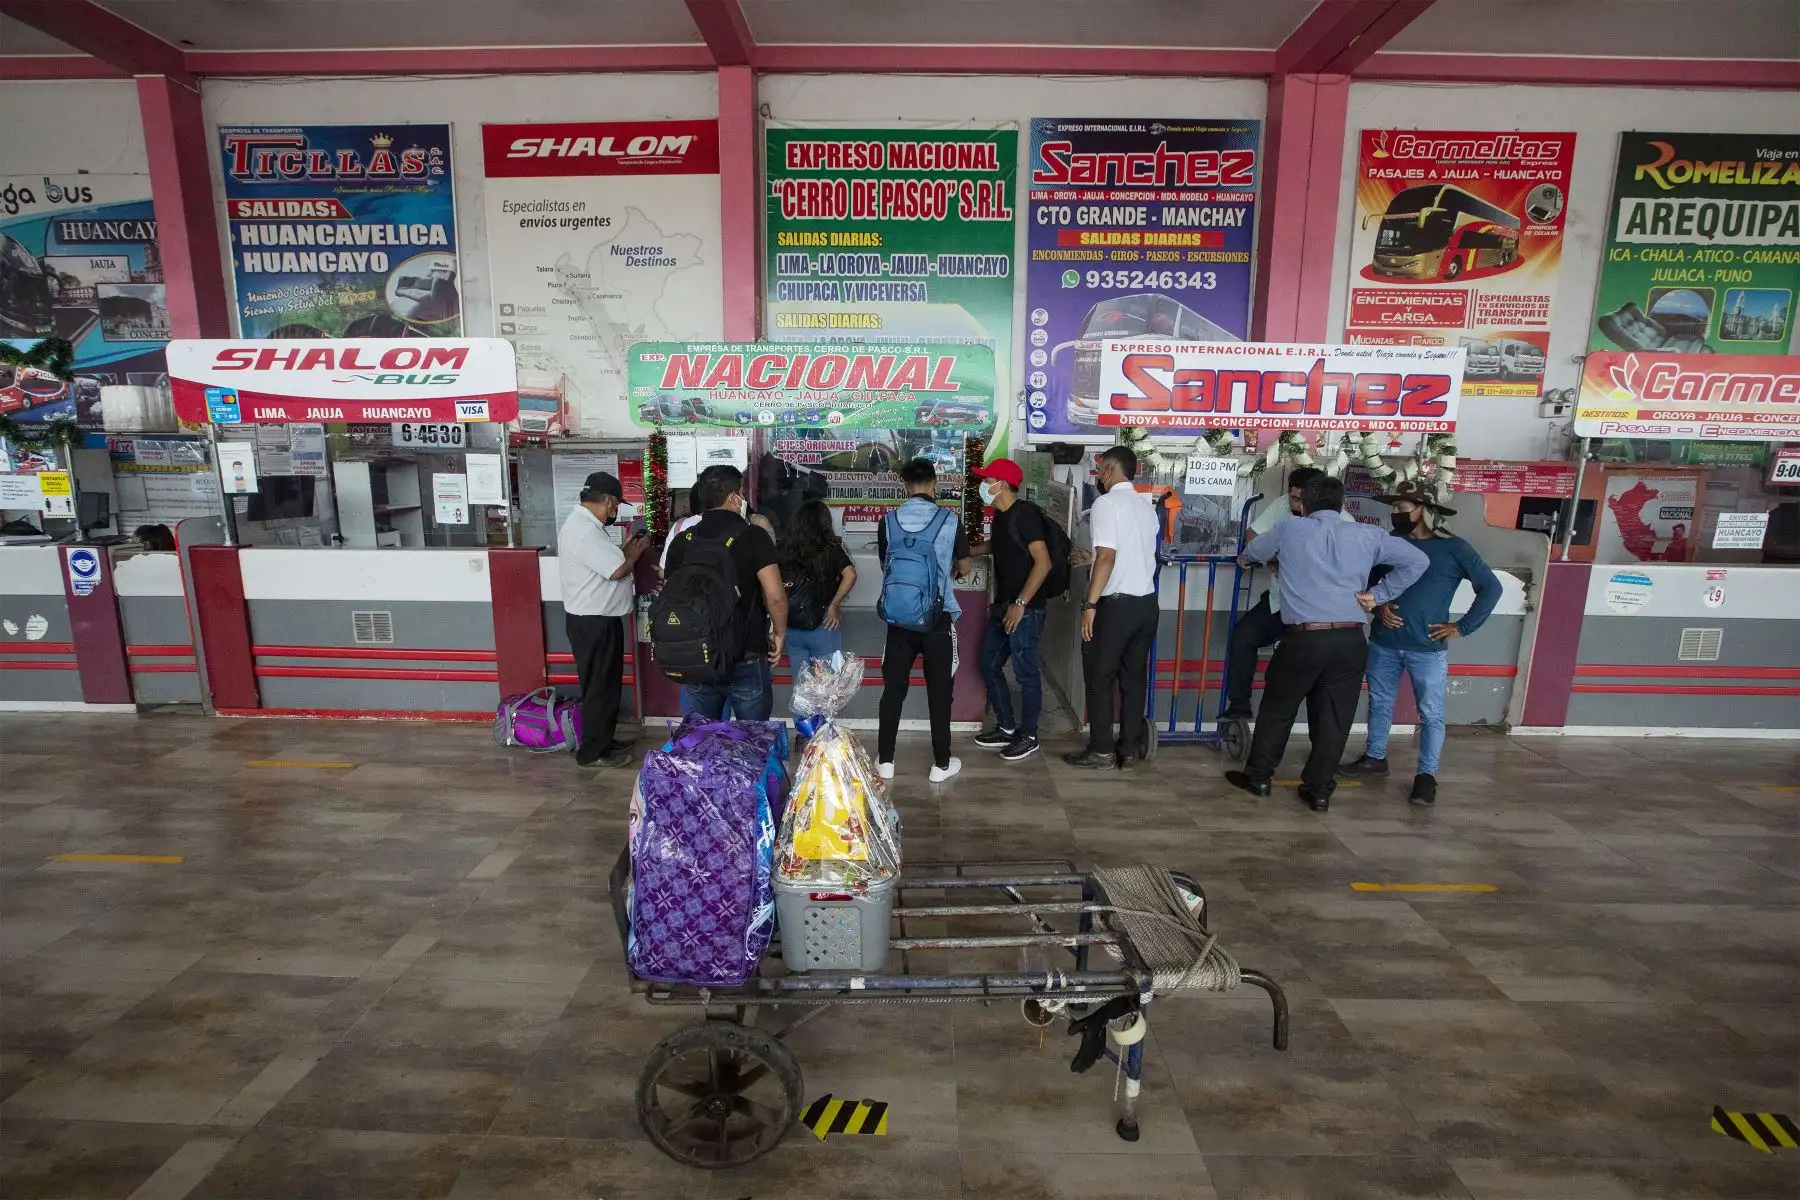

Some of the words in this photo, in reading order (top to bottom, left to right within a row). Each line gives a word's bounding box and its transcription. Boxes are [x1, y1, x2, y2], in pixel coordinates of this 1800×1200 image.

[1057, 124, 1083, 132] EXPRESO
[507, 135, 693, 158] SHALOM
[1392, 135, 1562, 159] Carmelitas
[226, 136, 427, 177] TICLLAS
[786, 142, 883, 170] EXPRESO
[889, 142, 998, 170] NACIONAL
[1756, 148, 1783, 161] Viaja
[1785, 151, 1799, 159] en
[1032, 140, 1255, 186] Sanchez
[1634, 141, 1800, 190] ROMELIZA
[1368, 168, 1425, 179] PASAJES
[1428, 169, 1437, 179] A
[1441, 169, 1479, 179] JAUJA
[1493, 170, 1562, 180] HUANCAYO
[43, 176, 94, 204] bus
[1031, 191, 1049, 200] LIMA
[1053, 192, 1077, 200] OROYA
[1082, 192, 1105, 200] JAUJA
[1110, 192, 1155, 200] CONCEPCION
[1180, 193, 1209, 201] MODELO
[1216, 193, 1254, 202] HUANCAYO
[502, 200, 570, 214] Especialistas
[572, 202, 586, 212] en
[851, 180, 878, 219] DE
[958, 181, 1012, 221] S.R.L.
[238, 201, 337, 217] SALIDAS:
[519, 215, 557, 229] envíos
[560, 215, 611, 230] urgentes
[1036, 206, 1072, 225] CTO
[1076, 206, 1147, 226] GRANDE
[1161, 207, 1247, 227] MANCHAY
[1624, 202, 1800, 240] AREQUIPA
[61, 221, 158, 241] HUANCAY
[240, 224, 448, 245] HUANCAVELICA
[777, 232, 828, 246] SALIDAS
[830, 232, 883, 246] DIARIAS:
[1080, 232, 1140, 245] SALIDAS
[1144, 232, 1202, 246] DIARIAS
[610, 245, 663, 256] Nuestros
[1032, 250, 1104, 261] ENCONMIENDAS
[1110, 251, 1139, 262] GIROS
[1146, 251, 1181, 262] PASEOS
[1187, 252, 1249, 263] ESCURSIONES
[1608, 248, 1631, 261] ICA
[1640, 249, 1685, 262] CHALA
[1693, 250, 1733, 263] ATICO
[1743, 250, 1800, 264] CAMANA
[90, 259, 116, 269] JAUJA
[243, 251, 389, 273] HUANCAYO
[625, 256, 677, 267] Destinos
[777, 254, 810, 275] LIMA
[819, 254, 835, 275] LA
[837, 254, 881, 276] OROYA
[889, 254, 929, 276] JAUJA
[937, 254, 1009, 277] HUANCAYO
[1085, 270, 1217, 290] 935246343
[1651, 268, 1705, 282] JULIACA
[1714, 269, 1753, 283] PUNO
[248, 288, 289, 302] Uniendo
[777, 281, 839, 302] CHUPACA
[843, 282, 854, 302] Y
[854, 282, 927, 303] VICEVERSA
[1478, 294, 1551, 303] ESPECIALISTAS
[1356, 295, 1463, 306] ENCOMIENDAS
[1381, 312, 1434, 322] CARGA
[1478, 309, 1549, 318] TRANSPORTE
[776, 313, 827, 328] SALIDAS
[829, 313, 883, 329] DIARIAS:
[1476, 317, 1486, 325] DE
[1487, 317, 1523, 325] CARGA
[129, 329, 173, 340] CONCEPC
[1349, 334, 1394, 345] MUDANZAS
[868, 346, 901, 354] PASCO
[1111, 343, 1172, 354] EXPRESO
[1175, 344, 1283, 356] INTERNACIONAL
[1285, 347, 1331, 357] E.I.R.L.
[1334, 348, 1355, 357] Donde
[1356, 349, 1372, 357] usted
[1376, 349, 1394, 359] Viaja
[1417, 352, 1422, 360] y
[211, 347, 470, 371] SHALOM
[660, 353, 961, 391] NACIONAL
[373, 374, 460, 385] BUS
[1110, 353, 1452, 418] Sanchez
[709, 391, 784, 400] HUANCAYO
[796, 391, 839, 400] JAUJA
[850, 391, 917, 401] CHUPACA
[253, 407, 287, 419] LIMA
[306, 407, 344, 419] JAUJA
[362, 407, 432, 419] HUANCAYO
[461, 406, 484, 415] VISA
[1581, 410, 1630, 418] DESTINOS:
[1652, 412, 1696, 420] OROYA
[1705, 412, 1743, 422] JAUJA
[1119, 415, 1160, 426] OROYA
[1168, 416, 1206, 427] JAUJA
[1296, 419, 1360, 430] HUANCAYO
[1368, 420, 1398, 430] MDO.
[1400, 421, 1448, 431] MODELO
[1600, 422, 1671, 435] PASAJES
[1700, 424, 1800, 438] ENCOMIENDAS
[806, 440, 856, 451] ORIGINALES
[797, 453, 822, 464] CAMA
[1189, 460, 1218, 471] 10:30
[1219, 462, 1237, 472] PM
[834, 472, 874, 481] EJECUTIVO
[1189, 477, 1206, 485] BUS
[1207, 477, 1233, 486] CAMA
[1660, 511, 1692, 519] NACIONAL
[1718, 529, 1762, 537] HUANCAYO
